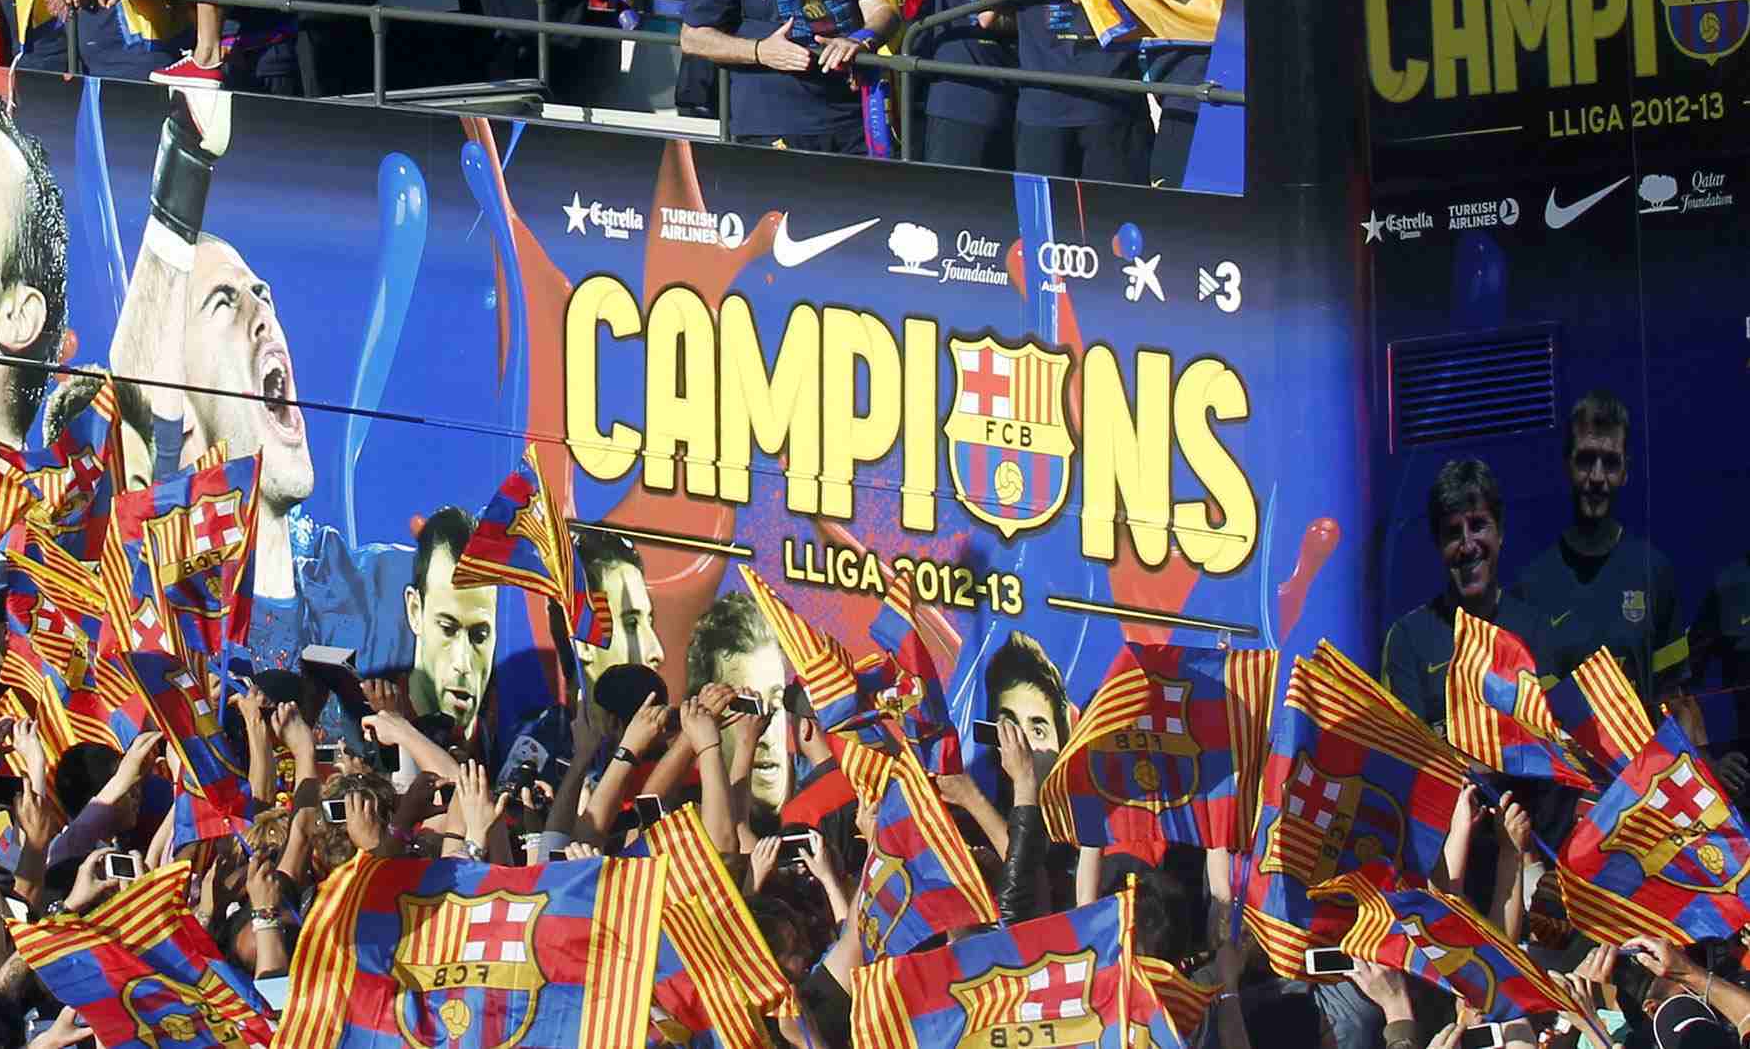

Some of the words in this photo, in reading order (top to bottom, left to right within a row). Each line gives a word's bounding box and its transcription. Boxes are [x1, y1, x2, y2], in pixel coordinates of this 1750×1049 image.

[1548, 104, 1624, 138] LLIGA
[1631, 91, 1725, 128] 2012-13
[1692, 170, 1726, 194] Qatar
[589, 201, 644, 231] Estrella
[660, 207, 718, 229] TURKISH
[1449, 201, 1497, 217] TURKISH
[1386, 212, 1434, 233] Estrella
[1449, 214, 1497, 230] AIRLINES
[660, 225, 718, 245] AIRLINES
[956, 230, 1000, 262] Qatar
[939, 258, 1008, 285] Foundation
[1041, 281, 1067, 294] Audi
[1214, 261, 1242, 313] 3
[985, 419, 1034, 448] FCB
[785, 539, 885, 593] LLIGA
